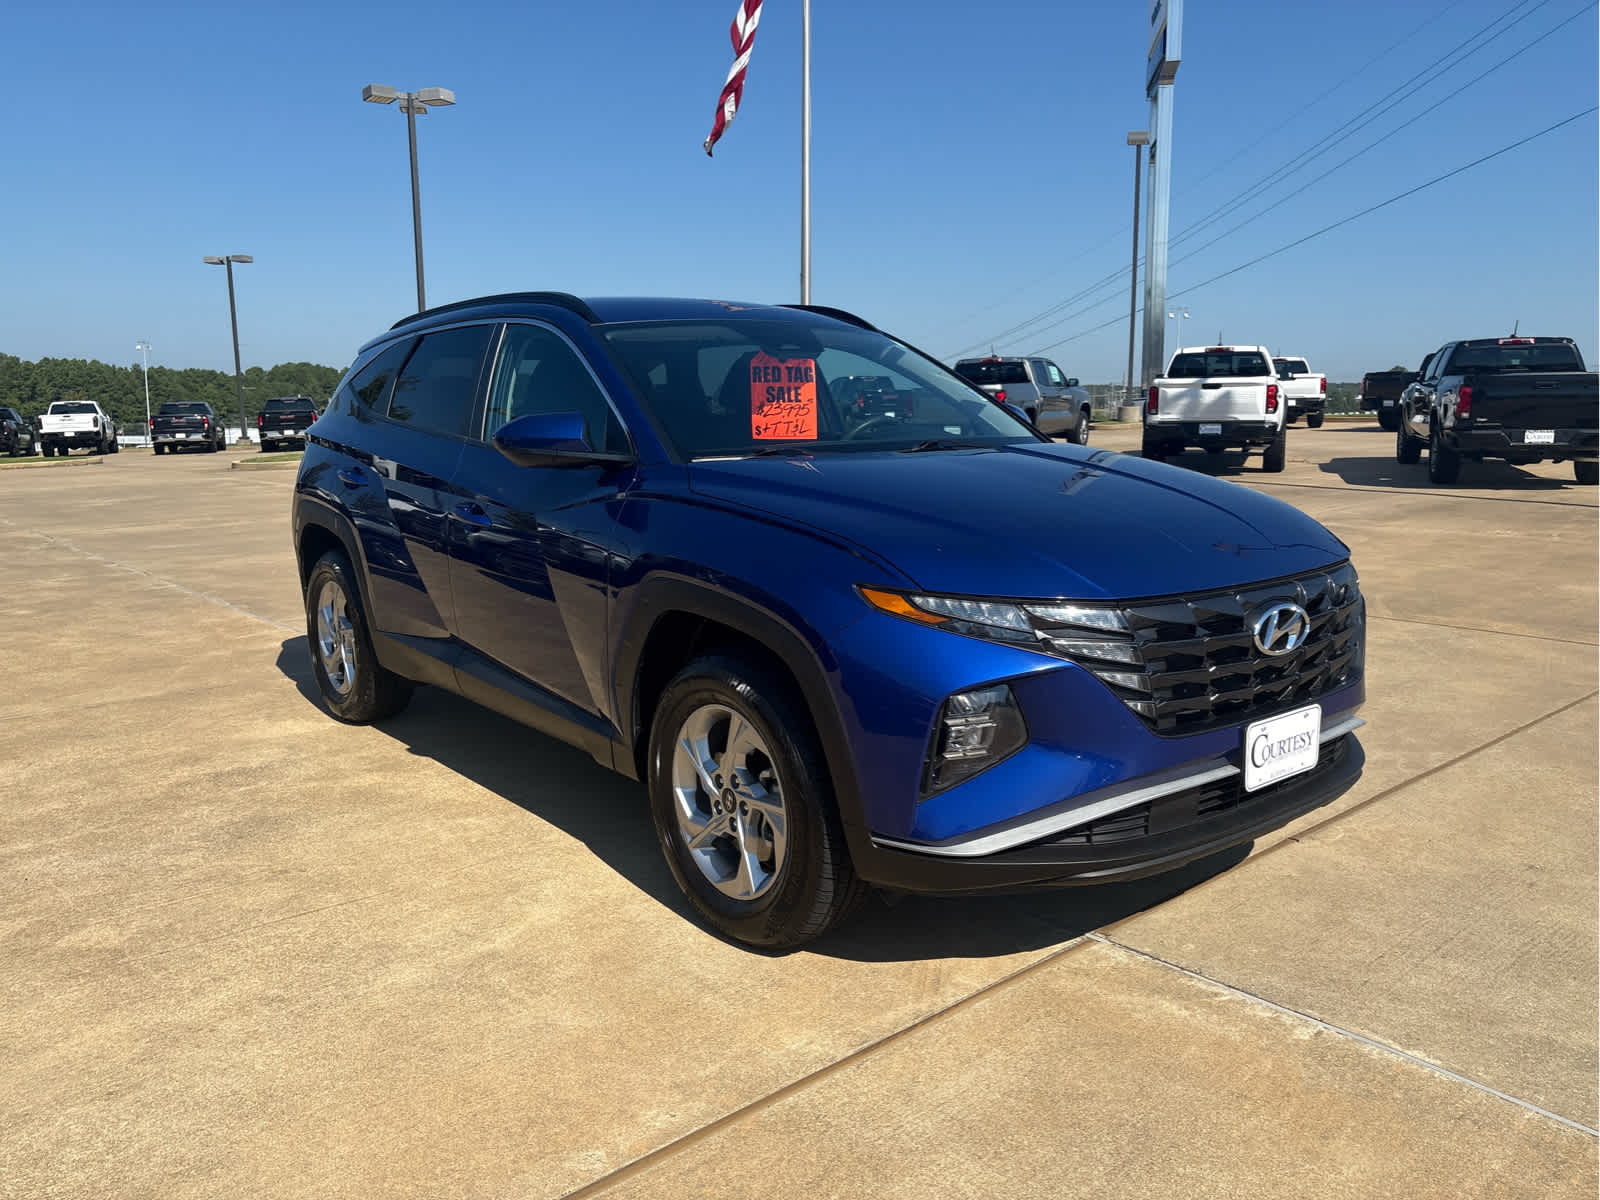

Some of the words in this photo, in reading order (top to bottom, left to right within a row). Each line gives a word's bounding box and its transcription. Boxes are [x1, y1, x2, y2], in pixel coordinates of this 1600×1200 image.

[752, 366, 781, 383] RED
[785, 366, 814, 383] TAG
[766, 386, 801, 403] SALE
